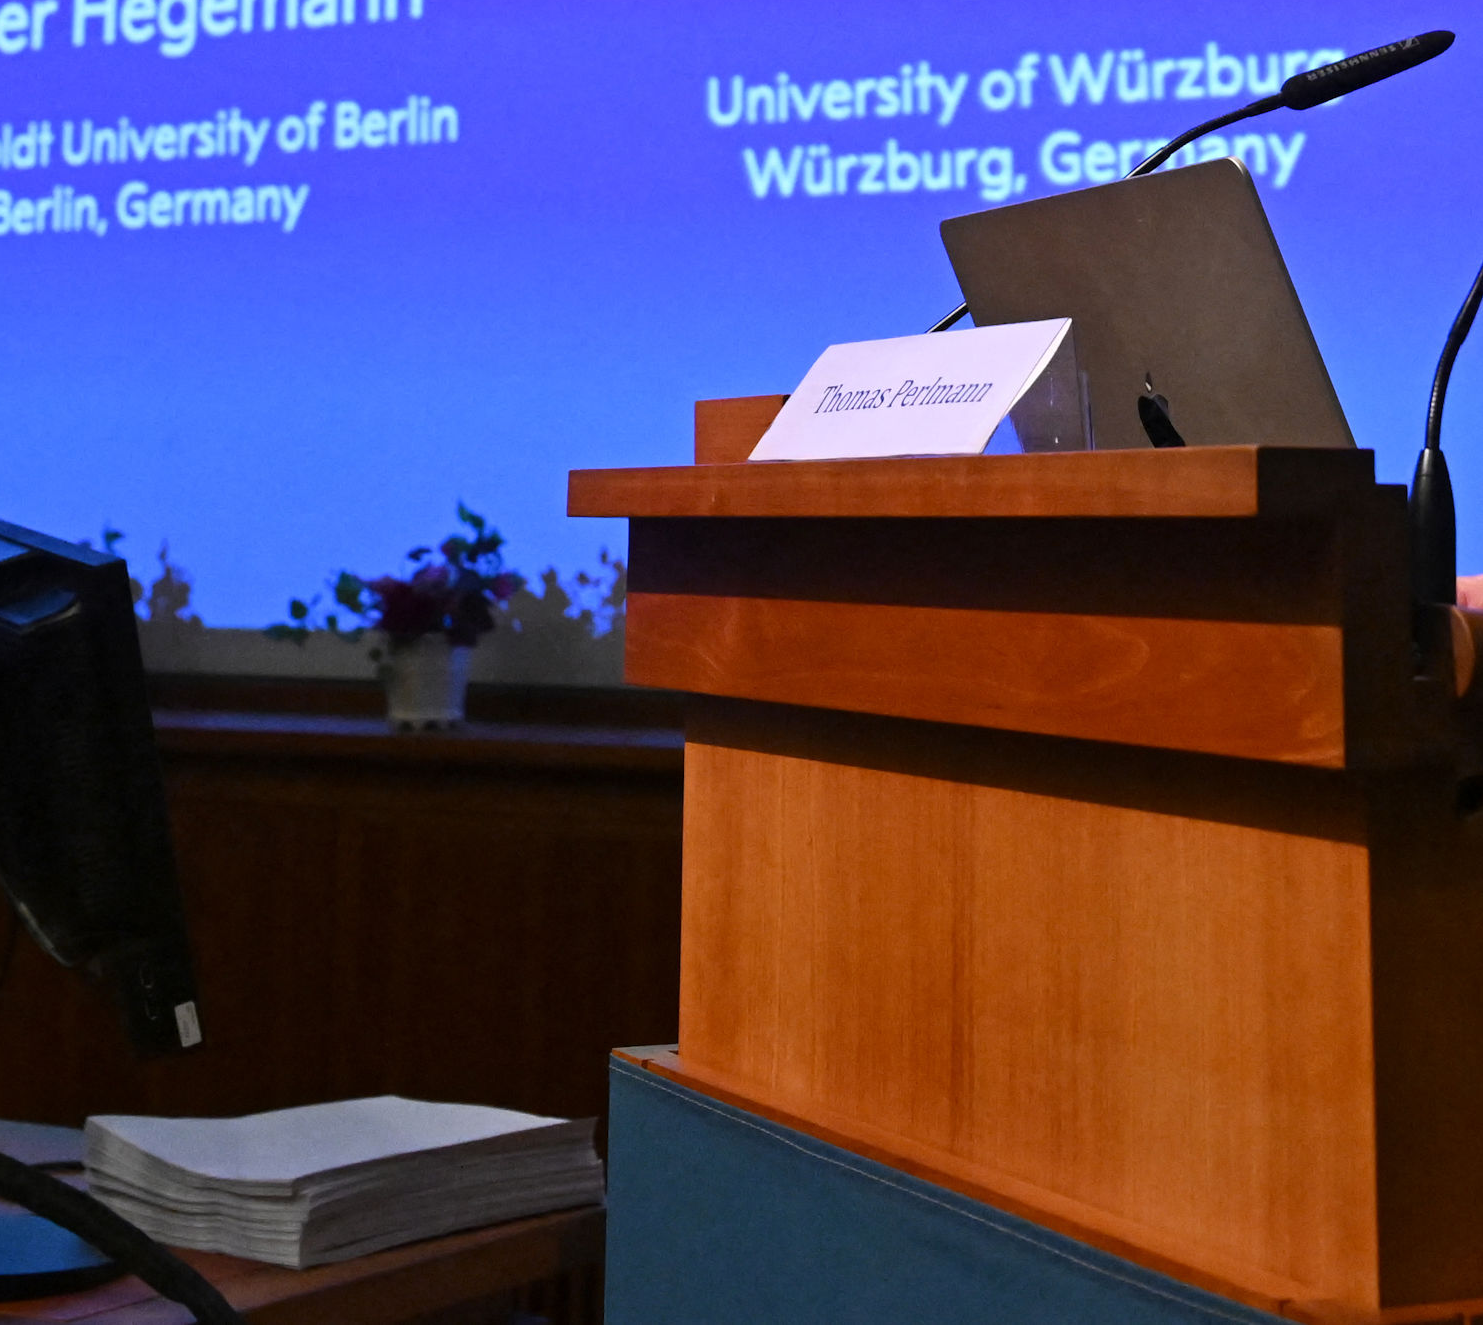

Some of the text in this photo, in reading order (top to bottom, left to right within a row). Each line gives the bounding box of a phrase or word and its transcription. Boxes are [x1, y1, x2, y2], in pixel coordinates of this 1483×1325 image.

[707, 60, 968, 127] University
[978, 52, 1041, 112] of
[1306, 45, 1397, 82] SENNHEISER
[61, 107, 271, 167] University
[276, 100, 327, 153] of
[333, 94, 459, 150] Berlin
[743, 138, 1028, 202] Würzburg,
[115, 180, 310, 232] Germany
[813, 376, 994, 415] Thomas Perlmann
